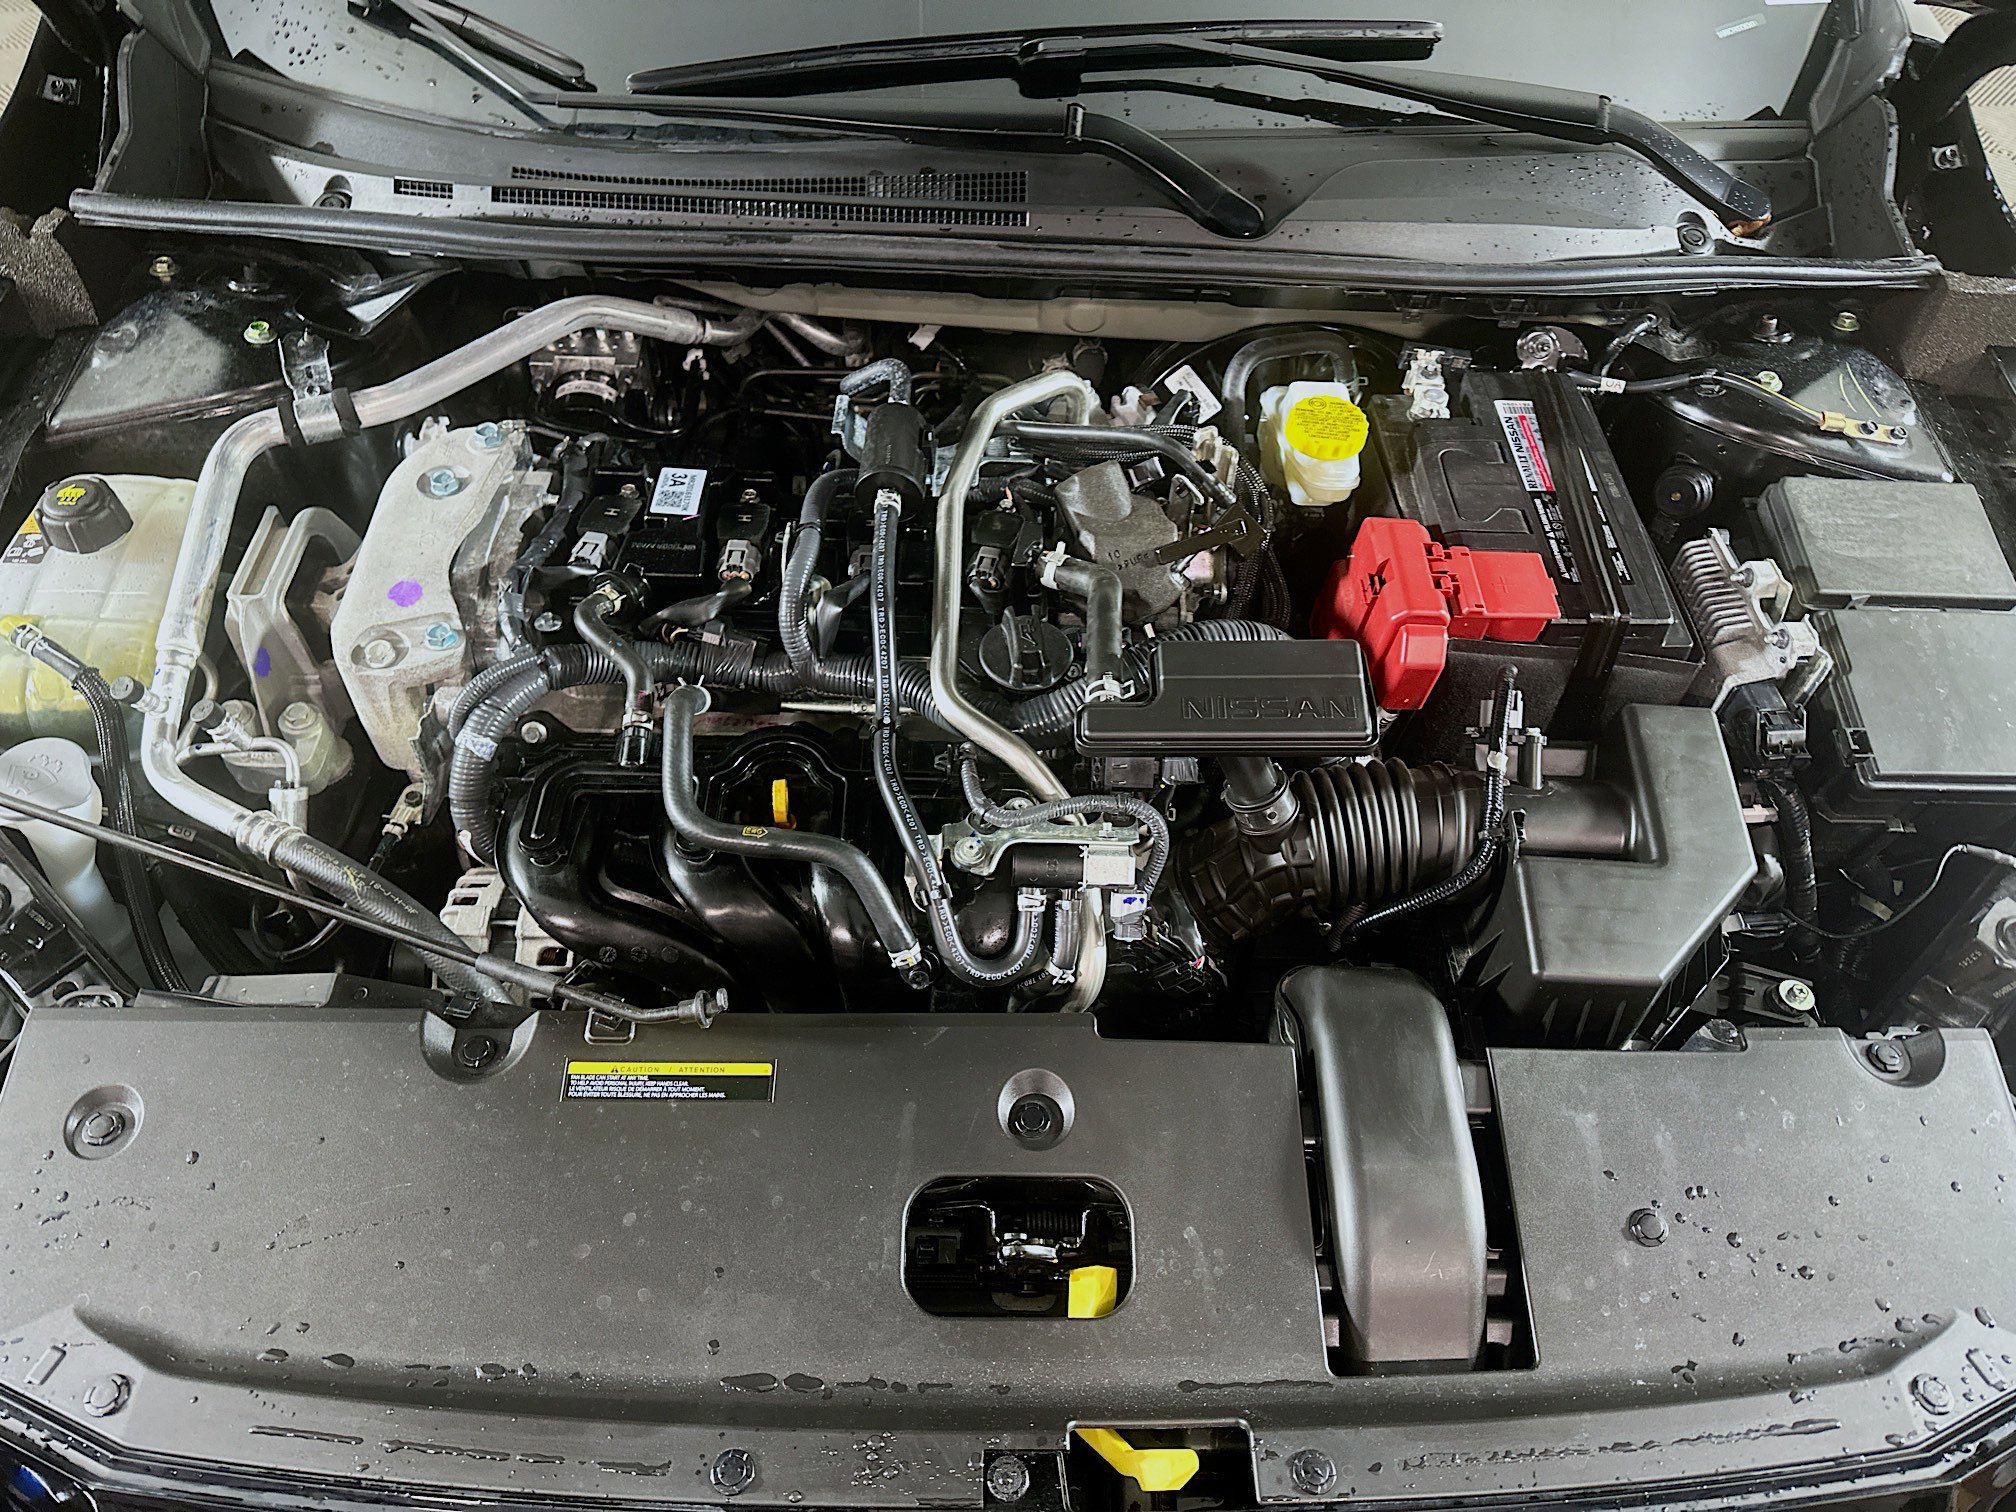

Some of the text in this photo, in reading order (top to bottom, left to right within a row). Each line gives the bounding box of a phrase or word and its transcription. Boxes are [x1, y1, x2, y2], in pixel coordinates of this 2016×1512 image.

[1503, 416, 1525, 453] NISSAN
[669, 473, 688, 487] 3A
[1181, 695, 1358, 719] NISSAN
[877, 607, 888, 670] TRD>ECO<4Z07
[890, 779, 918, 831] TRD>ECO<4Z07
[937, 904, 965, 966] TRD>ECO<4Z07
[965, 962, 1024, 981] TRD>ECO<4Z07
